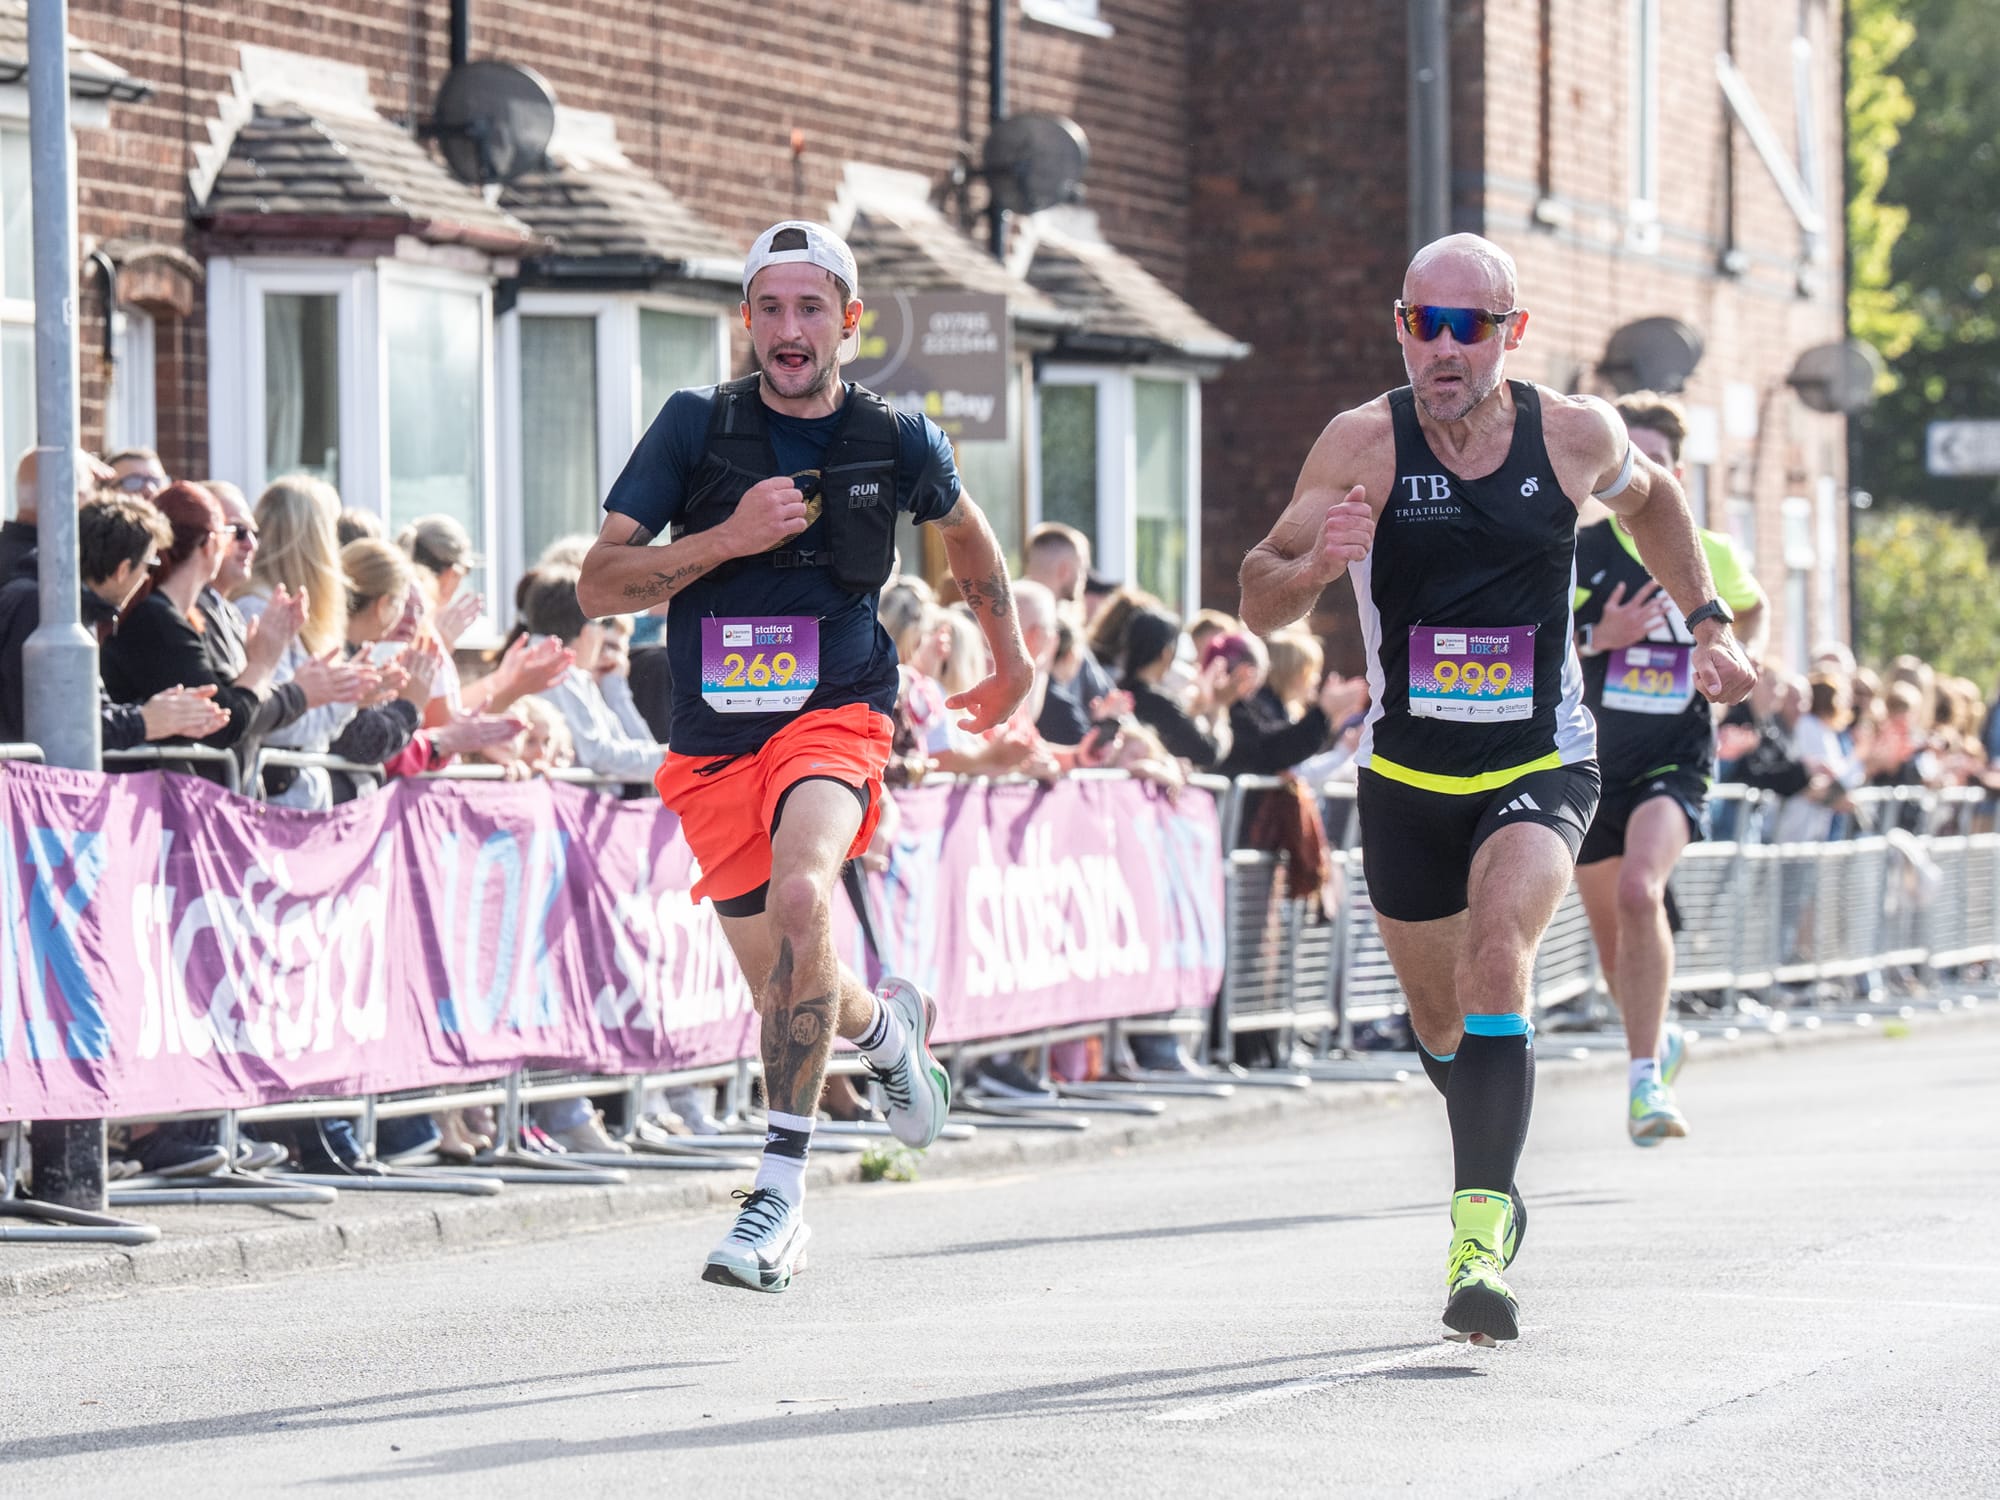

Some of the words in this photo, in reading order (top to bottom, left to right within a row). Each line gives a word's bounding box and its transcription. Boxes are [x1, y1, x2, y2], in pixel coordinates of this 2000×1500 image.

[849, 483, 880, 497] RUN
[1402, 474, 1451, 502] TB
[1395, 506, 1462, 518] TRIATHLON
[754, 625, 793, 634] stafford
[756, 635, 777, 645] 10K
[1469, 635, 1510, 644] stafford
[1470, 644, 1492, 654] 10K
[723, 652, 797, 687] 269
[1433, 661, 1512, 696] 999
[1622, 667, 1674, 696] 430
[132, 828, 394, 1061] stafford
